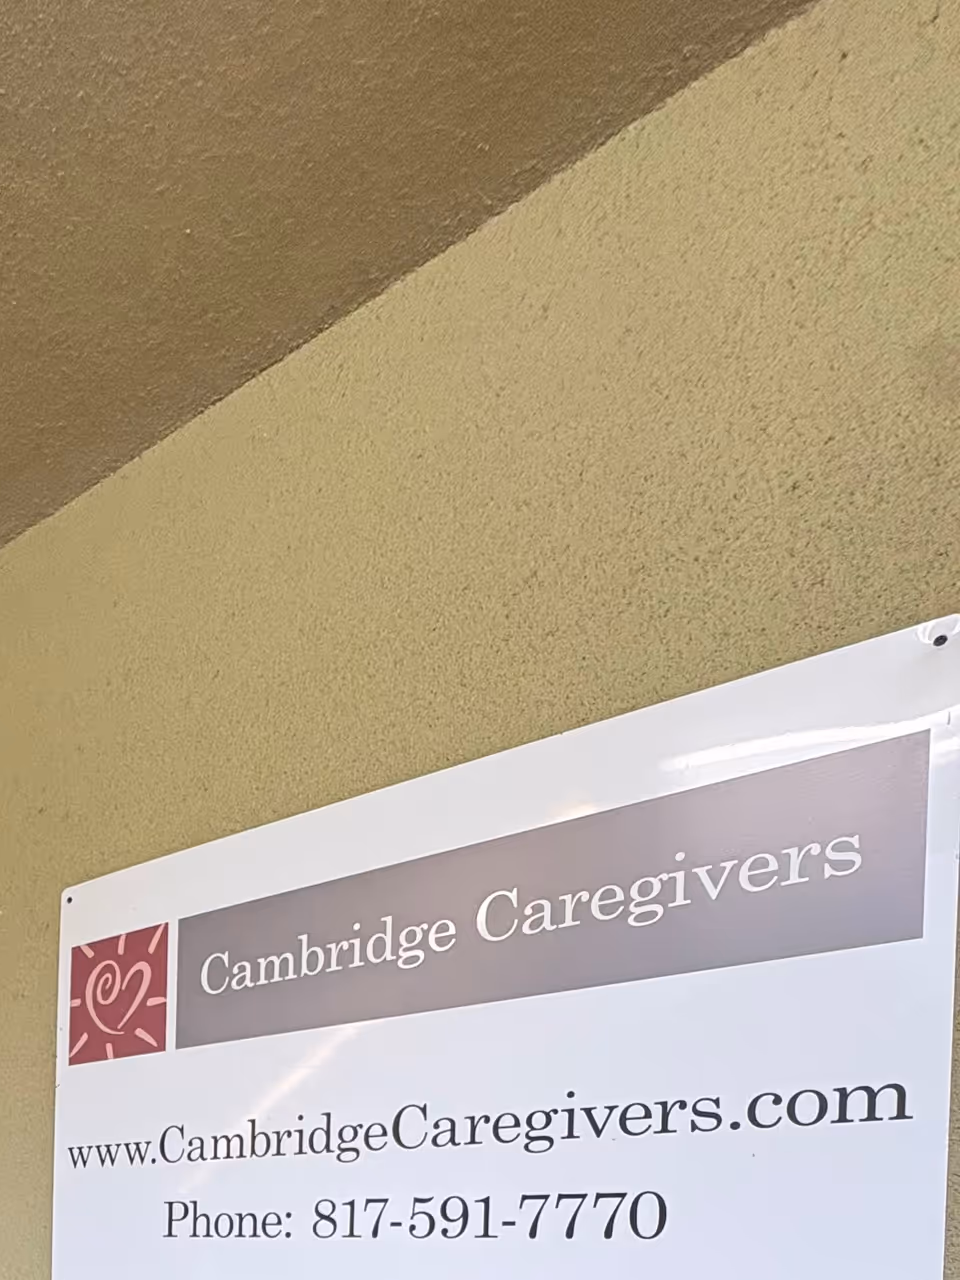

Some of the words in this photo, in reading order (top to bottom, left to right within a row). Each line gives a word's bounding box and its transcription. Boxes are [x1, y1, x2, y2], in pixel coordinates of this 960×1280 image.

[200, 915, 457, 995] Cambridge
[476, 834, 863, 942] Caregivers
[67, 1083, 915, 1169] www.CambridgeCaregivers.com
[163, 1201, 292, 1239] Phone:
[312, 1190, 667, 1240] 817-591-7770
